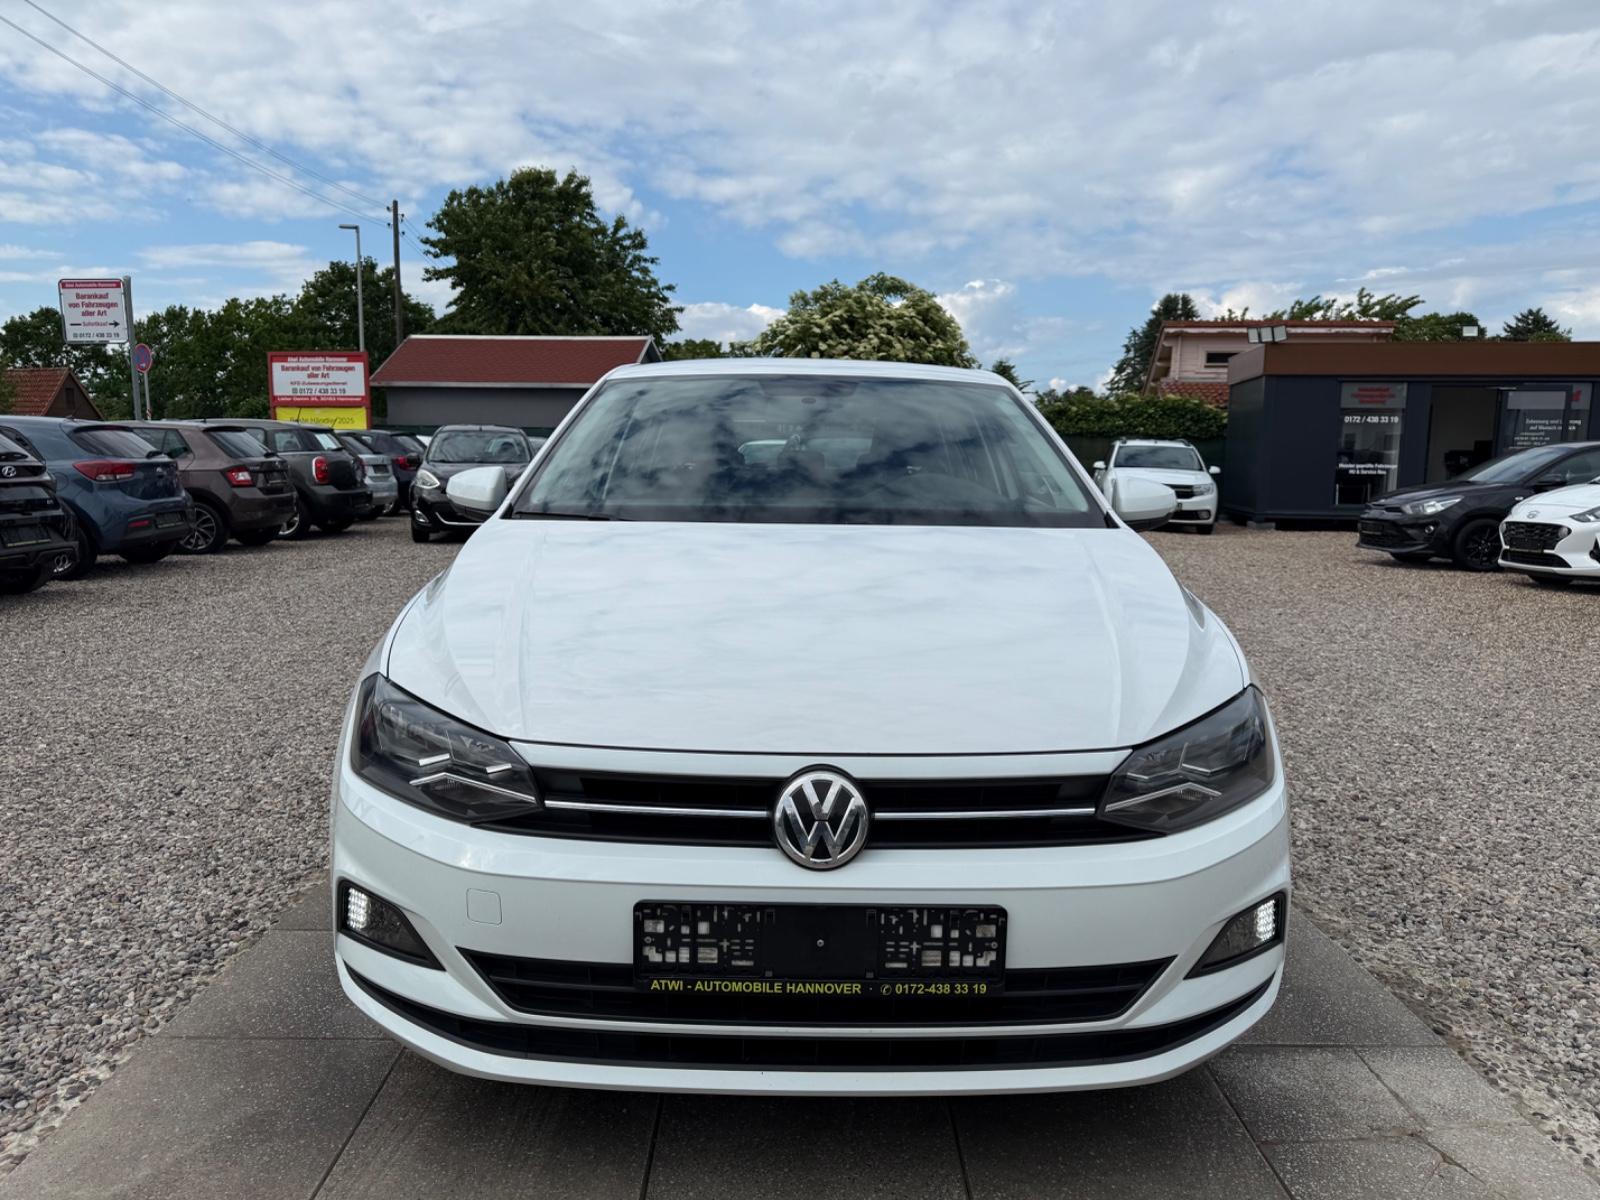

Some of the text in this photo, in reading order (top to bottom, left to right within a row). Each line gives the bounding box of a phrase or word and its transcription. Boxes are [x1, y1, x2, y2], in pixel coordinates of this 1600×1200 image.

[322, 365, 356, 373] Fahrzeugen
[651, 979, 684, 991] ATWI
[694, 981, 783, 993] AUTOMOBILE
[786, 982, 862, 994] HANNOVER
[895, 983, 951, 994] 0172-438
[954, 983, 969, 994] 33
[972, 983, 987, 994] 19
